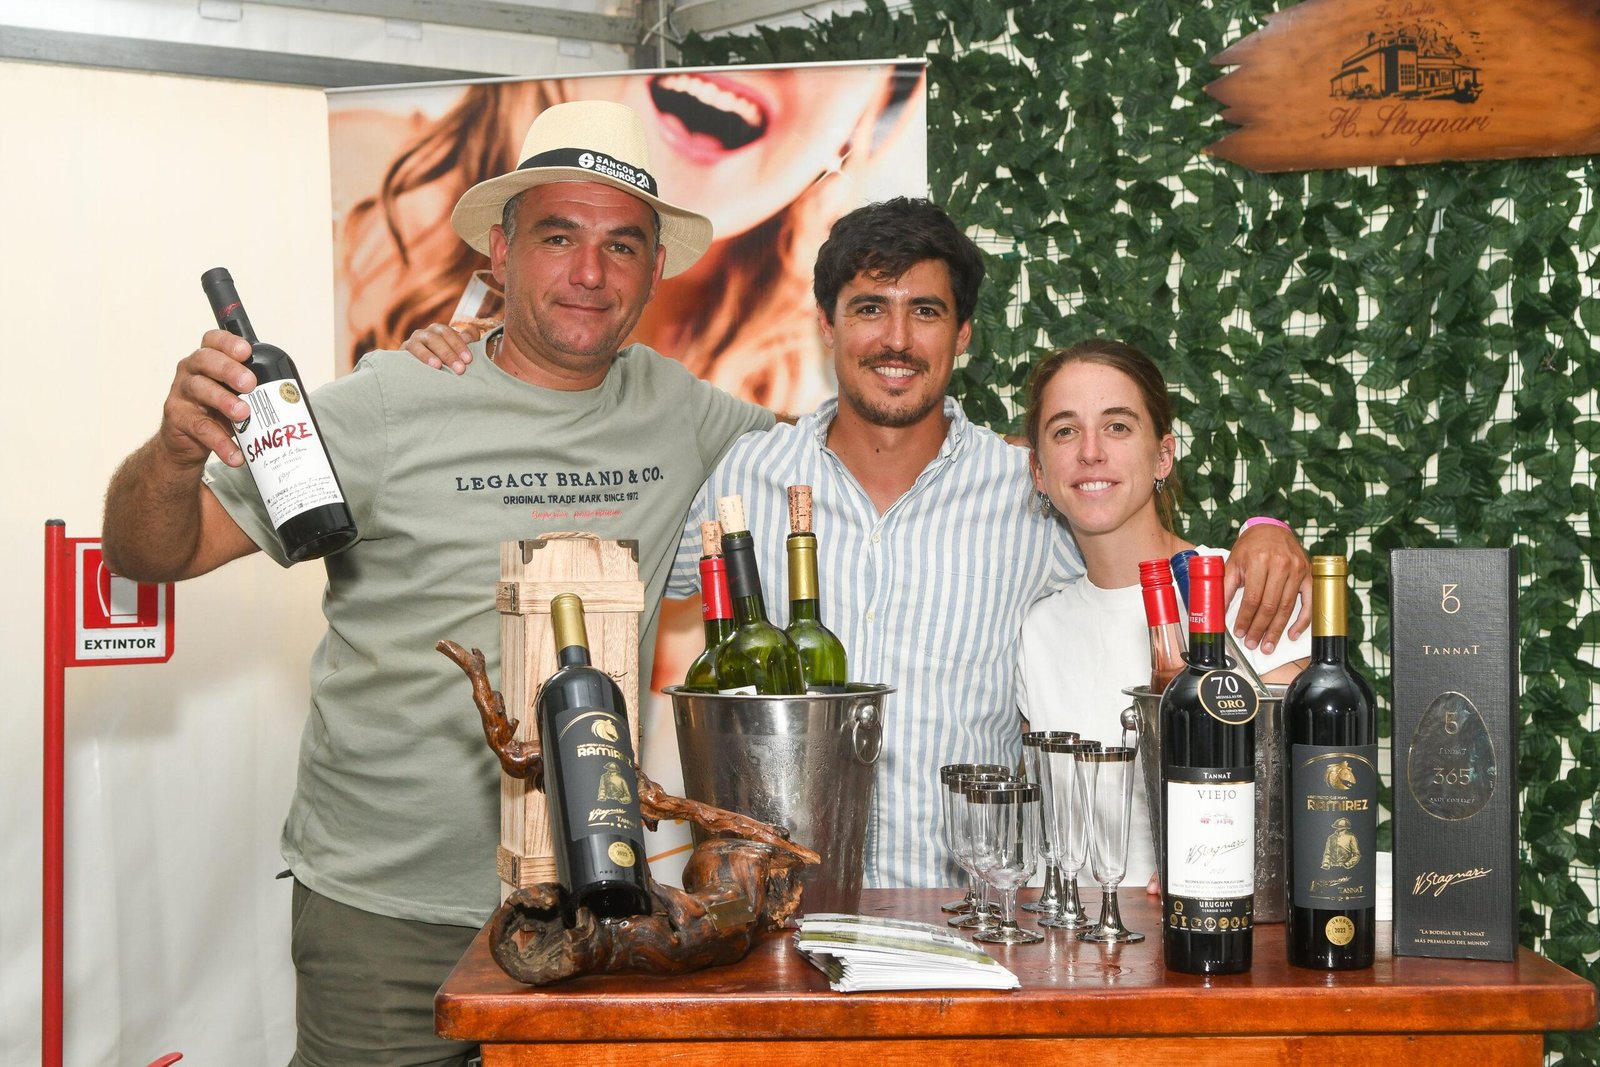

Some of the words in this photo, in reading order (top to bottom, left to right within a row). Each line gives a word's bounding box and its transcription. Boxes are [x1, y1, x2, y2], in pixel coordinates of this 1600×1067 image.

[1369, 102, 1493, 147] Stagnari
[594, 163, 637, 184] SEGUROS
[595, 155, 635, 177] SANCOR
[248, 388, 280, 430] PURA
[246, 421, 313, 463] SANGRE
[455, 472, 549, 492] LEGACY
[556, 470, 624, 487] BRAND
[628, 469, 639, 484] &
[642, 466, 664, 483] CO.
[503, 495, 546, 505] ORIGINAL
[548, 494, 577, 504] TRADE
[578, 493, 602, 504] MARK
[603, 492, 625, 502] SINCE
[626, 491, 639, 501] 1972
[84, 638, 156, 650] EXTINTOR
[1422, 644, 1480, 655] TANNAT
[1210, 675, 1239, 695] 70
[1217, 699, 1246, 709] ORO
[1444, 711, 1459, 735] 5
[1203, 771, 1232, 779] TANNAT
[1432, 767, 1471, 785] 365
[1197, 789, 1237, 802] VIEJO
[1307, 798, 1369, 812] RAMIREZ
